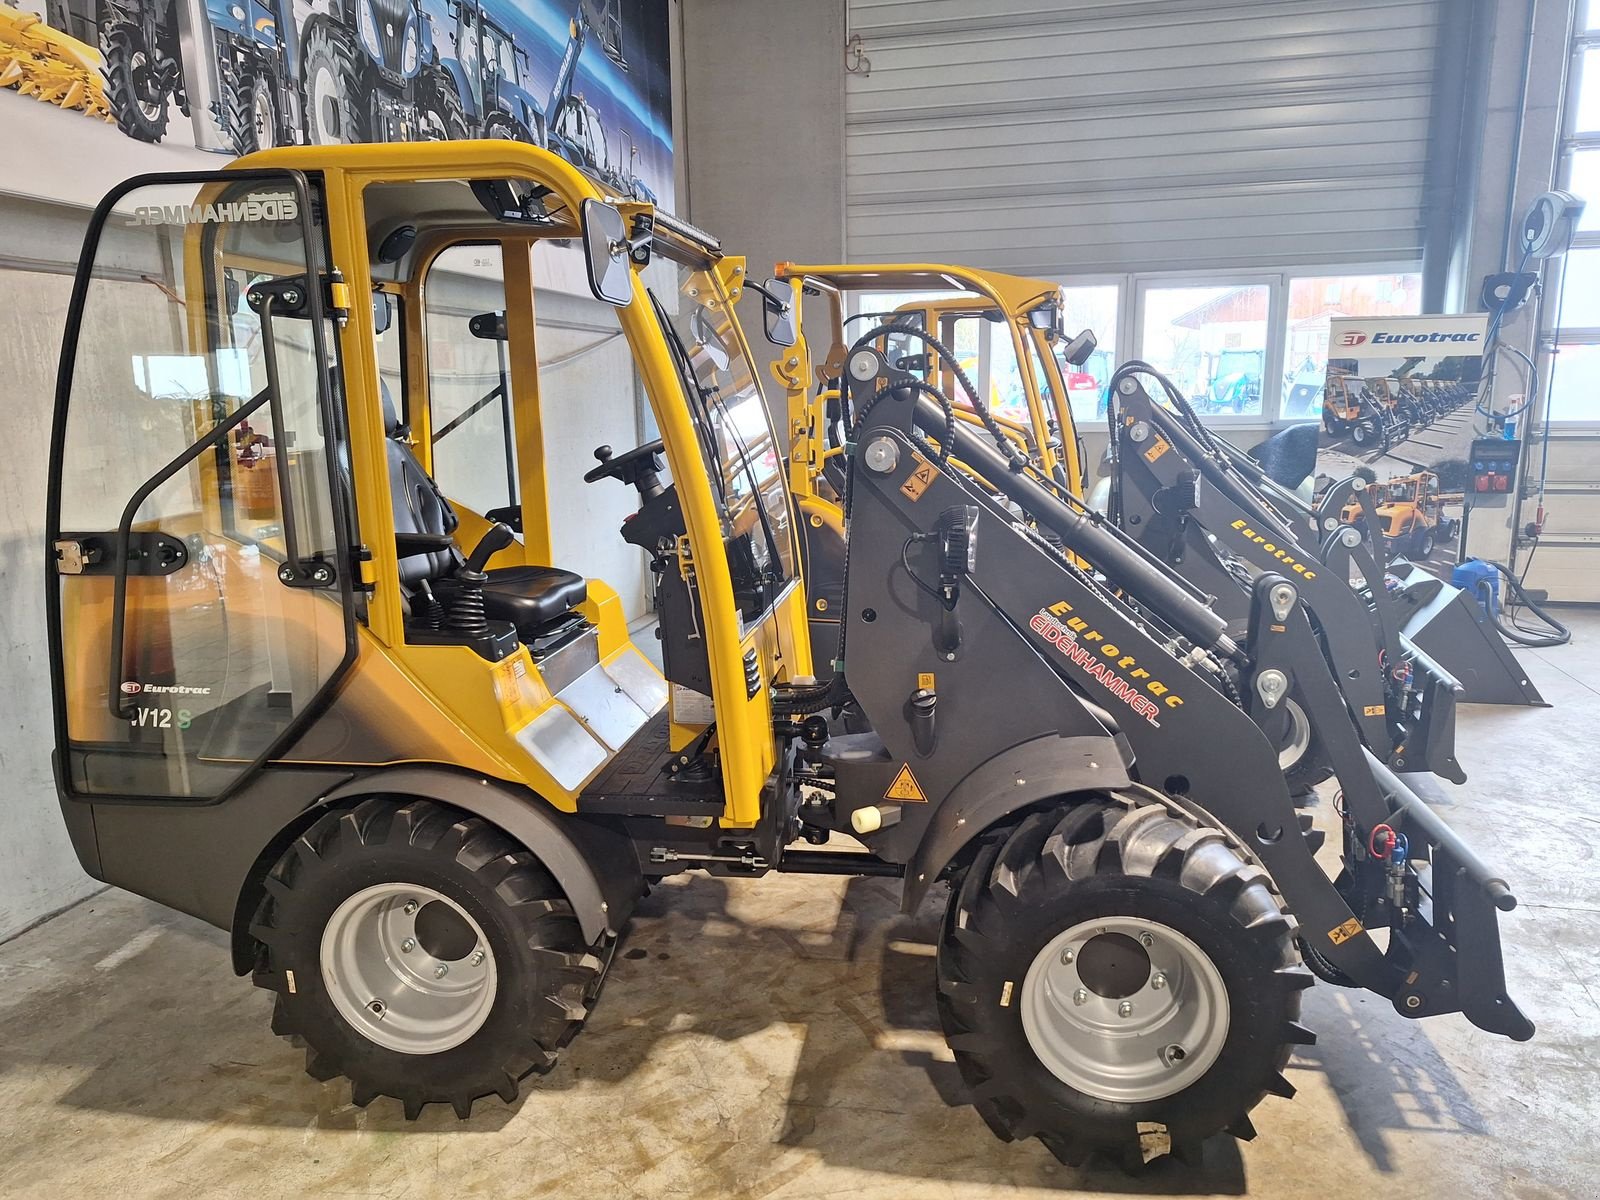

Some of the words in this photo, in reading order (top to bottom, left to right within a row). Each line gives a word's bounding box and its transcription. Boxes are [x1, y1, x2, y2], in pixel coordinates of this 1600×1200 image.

[1370, 332, 1480, 345] Eurotrac
[1230, 519, 1317, 580] Eurotrac
[1029, 613, 1160, 722] EIDENHAMMER
[1047, 600, 1184, 708] Eurotrac
[143, 683, 211, 695] Eurotrac
